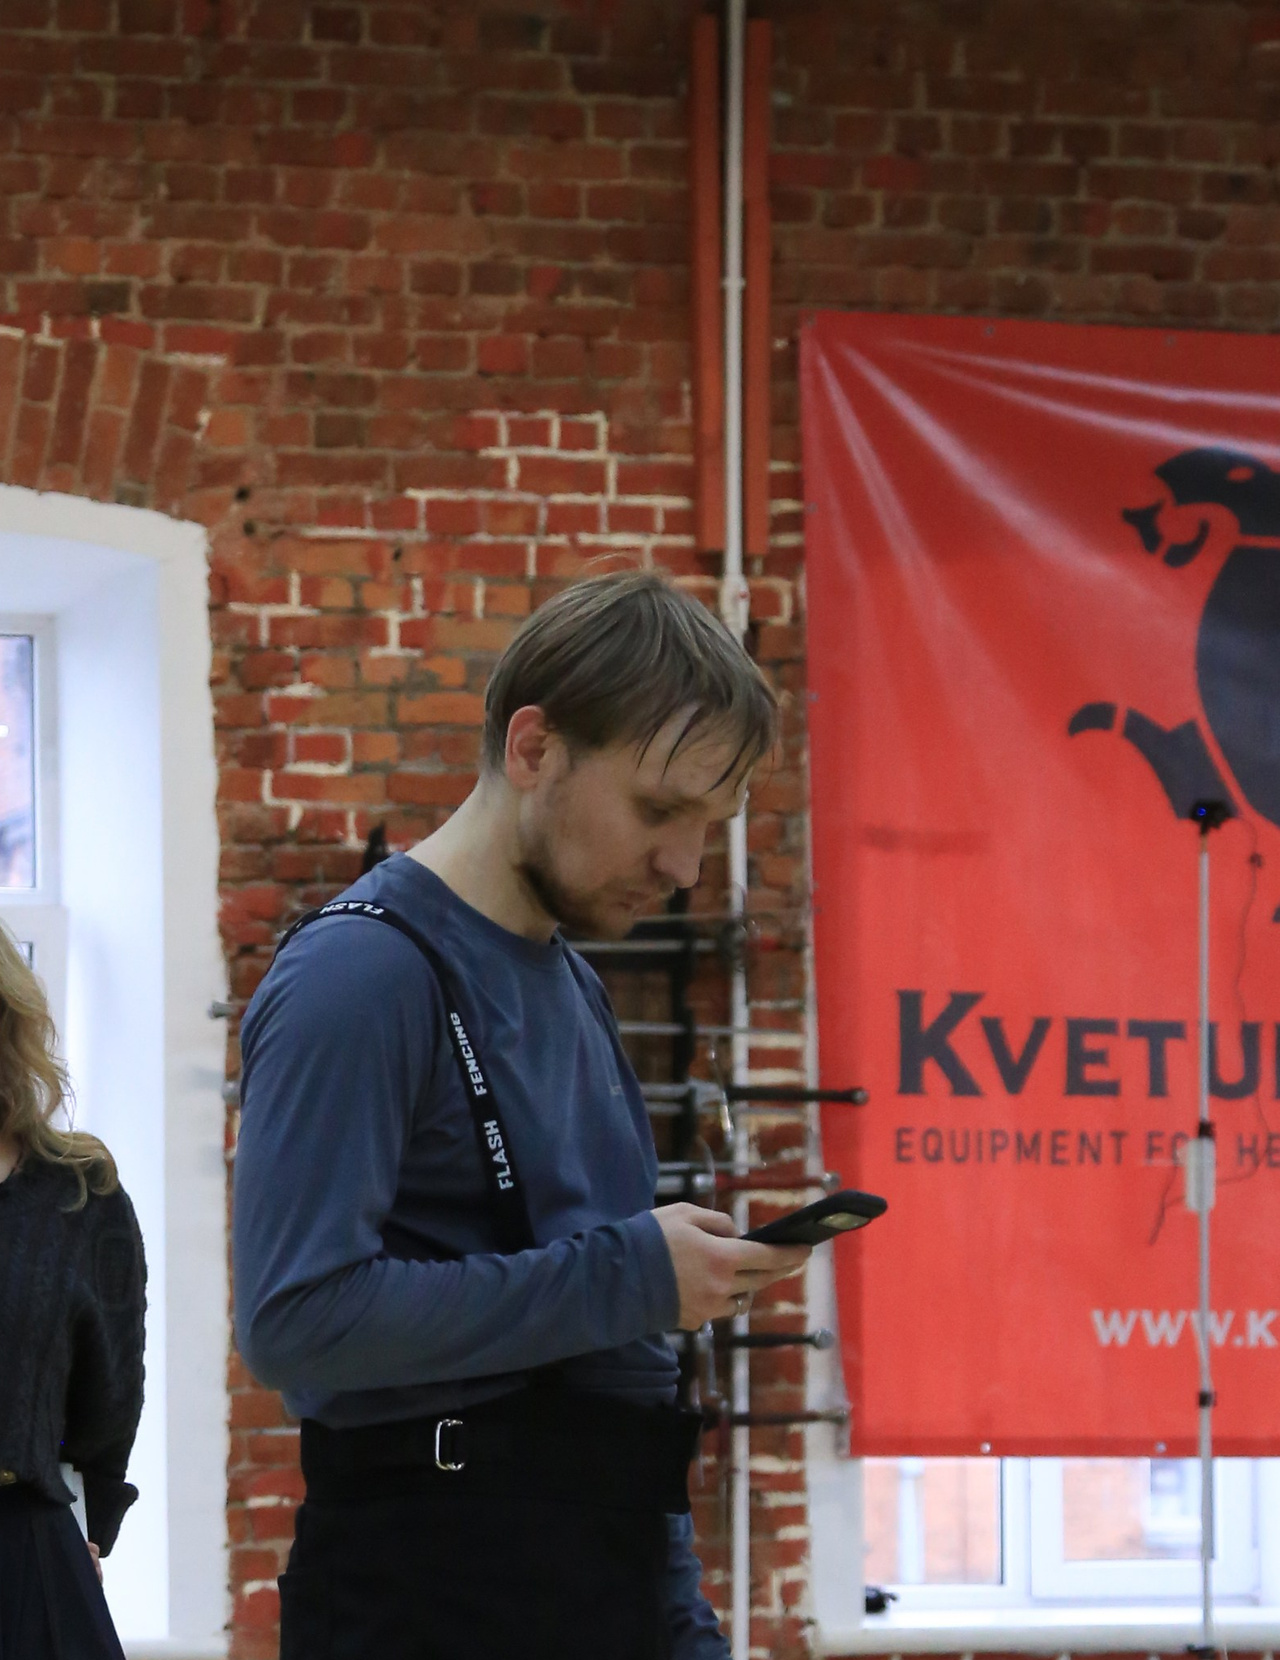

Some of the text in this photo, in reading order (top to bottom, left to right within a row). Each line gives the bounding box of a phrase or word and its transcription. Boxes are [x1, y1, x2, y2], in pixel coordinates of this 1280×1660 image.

[319, 902, 385, 915] FLASH
[895, 988, 1280, 1100] KVETU
[450, 1012, 514, 1190] FLASH FENCING
[894, 1126, 1128, 1167] EQUIPMENT
